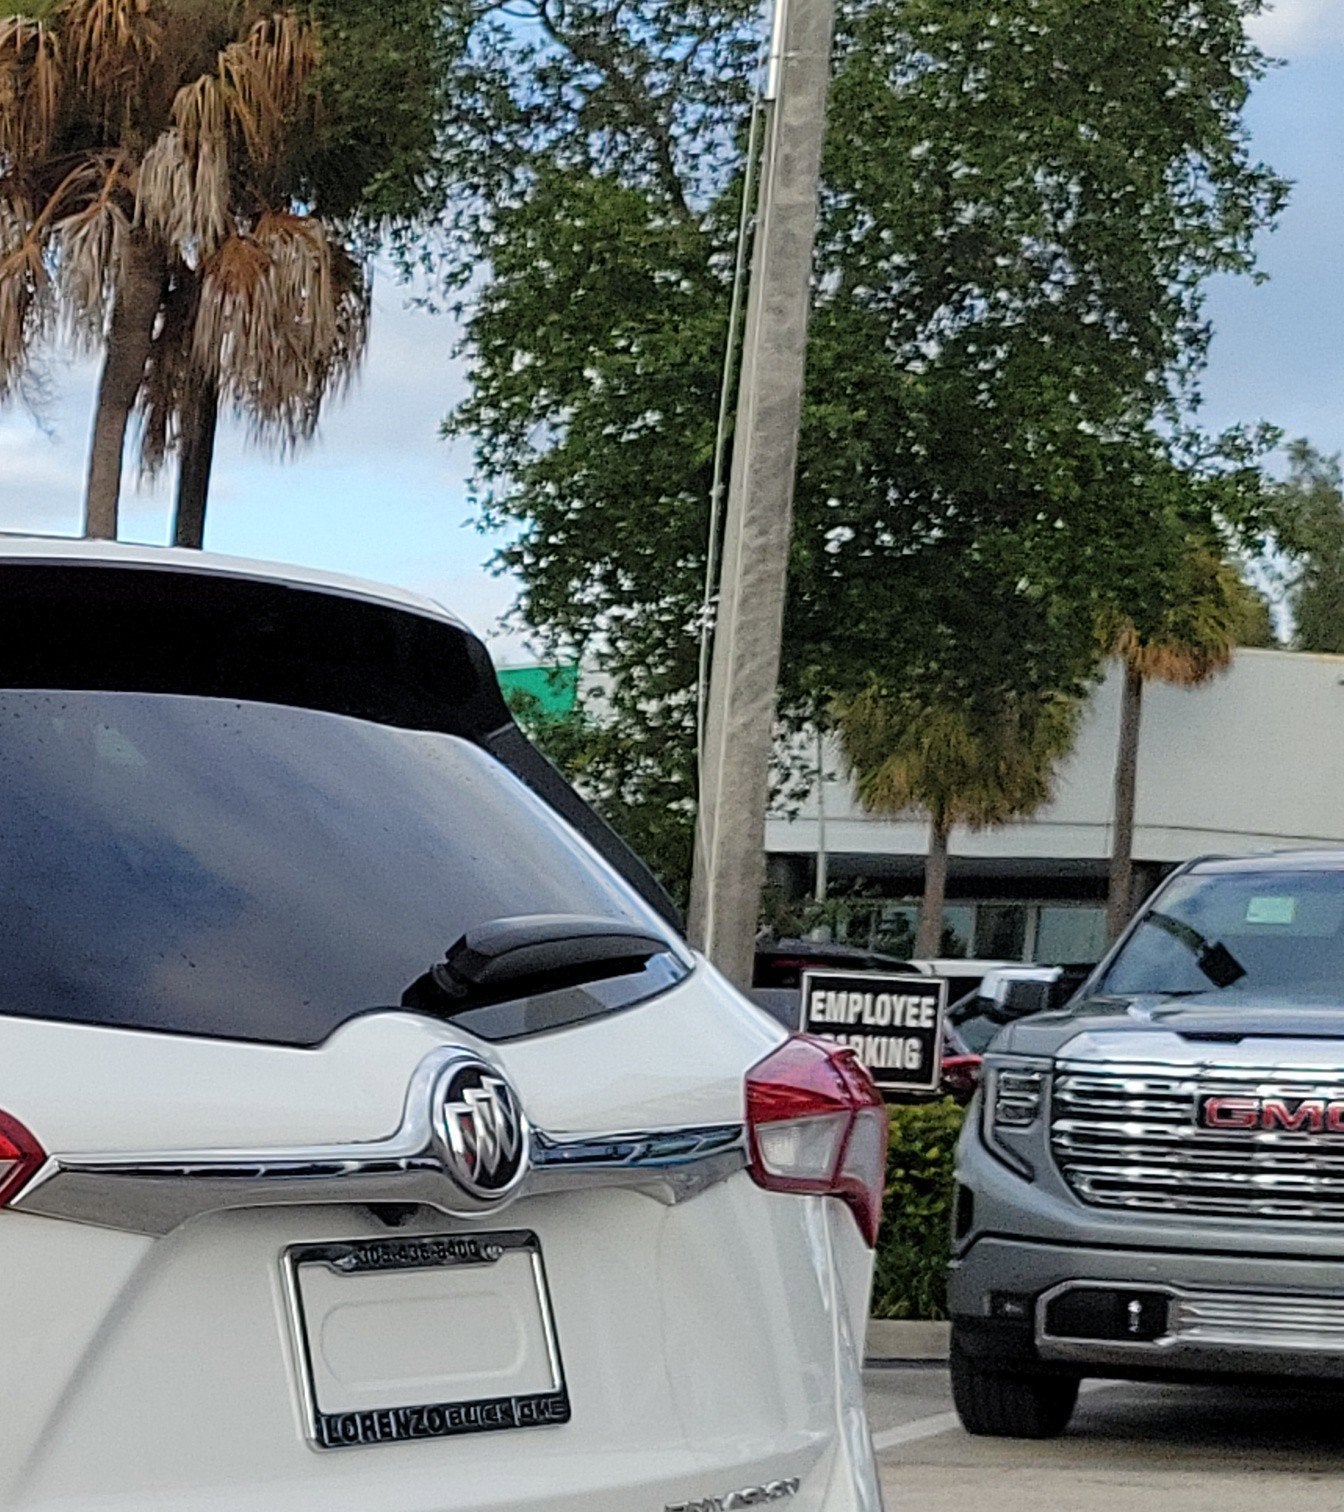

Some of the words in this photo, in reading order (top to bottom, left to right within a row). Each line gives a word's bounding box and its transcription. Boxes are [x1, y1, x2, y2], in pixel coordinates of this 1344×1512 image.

[810, 990, 936, 1028] EMPLOYEE
[322, 1407, 444, 1447] LORENZO
[444, 1402, 512, 1429] BUICK
